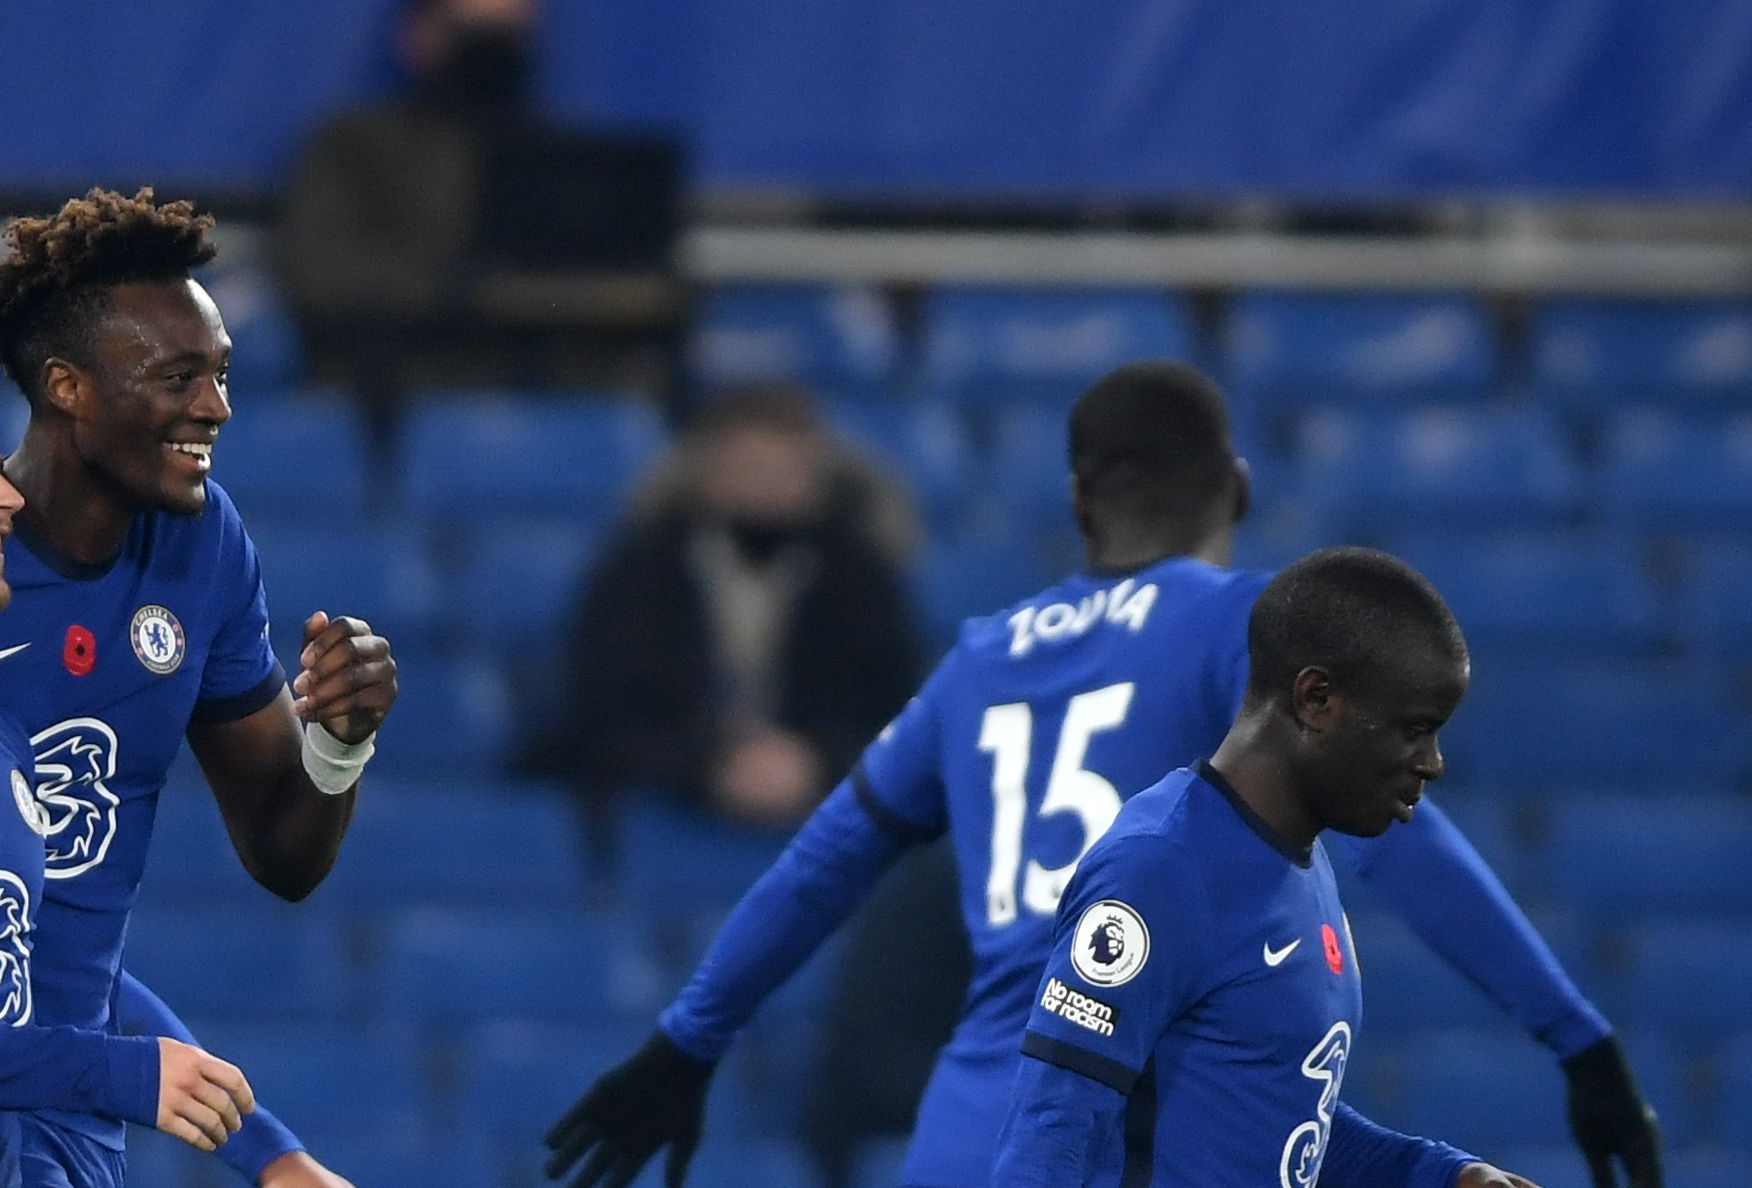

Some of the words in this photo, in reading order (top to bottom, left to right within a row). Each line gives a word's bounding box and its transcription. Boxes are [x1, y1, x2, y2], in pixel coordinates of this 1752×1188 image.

[136, 608, 168, 626] CHELSEA
[977, 681, 1135, 926] 15
[1047, 978, 1066, 998] No
[1067, 991, 1112, 1020] room
[1059, 1004, 1114, 1036] racism
